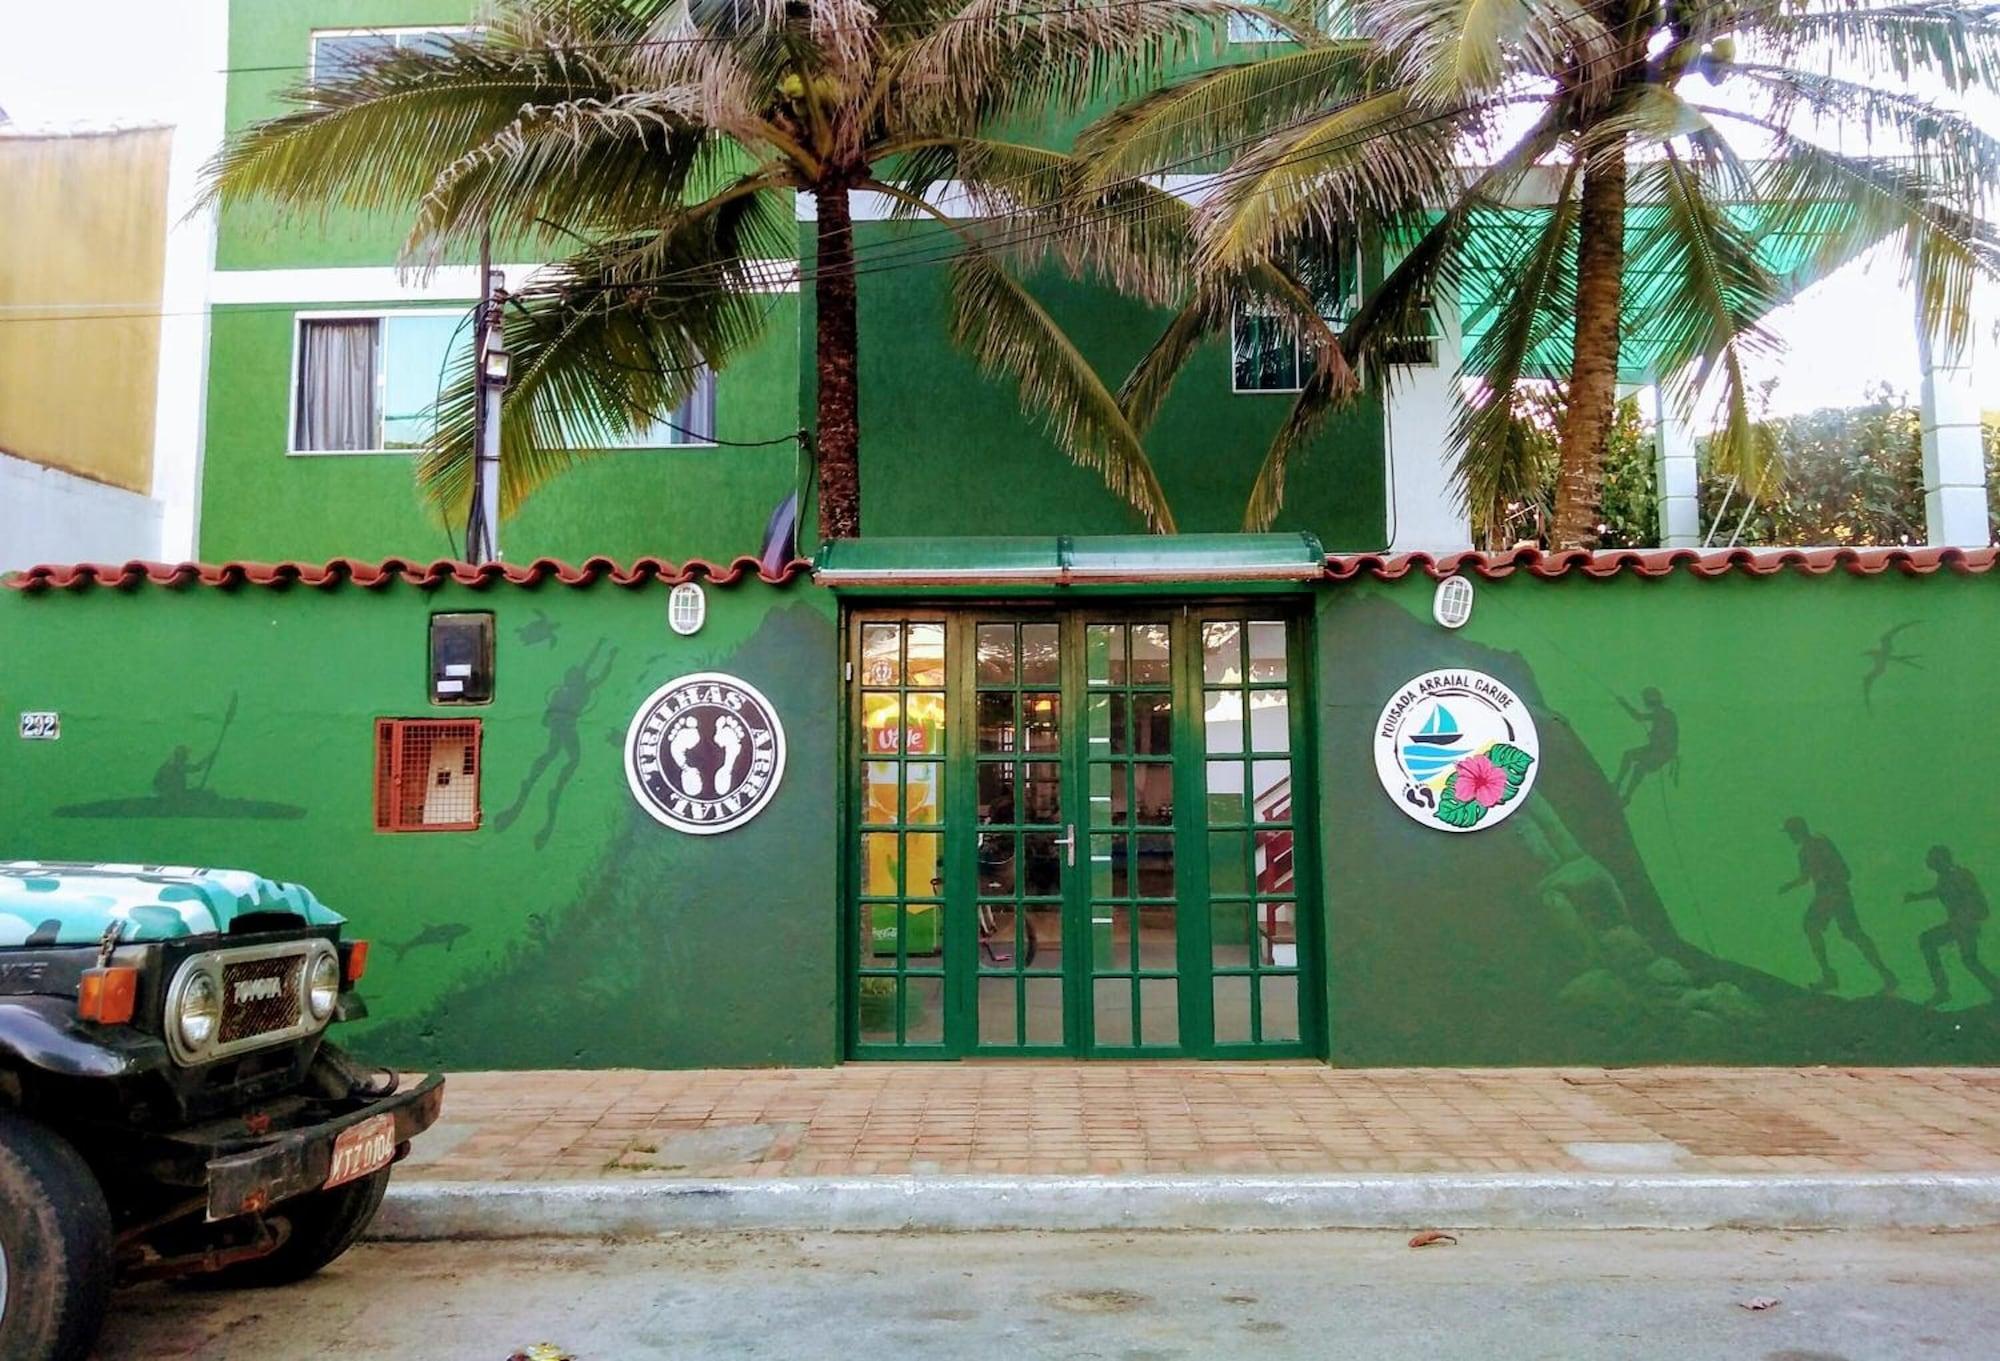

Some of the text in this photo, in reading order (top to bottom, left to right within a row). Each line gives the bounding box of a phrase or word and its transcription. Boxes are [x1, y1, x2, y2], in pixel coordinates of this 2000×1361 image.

[1381, 674, 1514, 739] POUSADA ARRAIAL CARIBE
[639, 685, 773, 820] TRILHAS ARRAIAL
[234, 976, 282, 1004] TOYOTA
